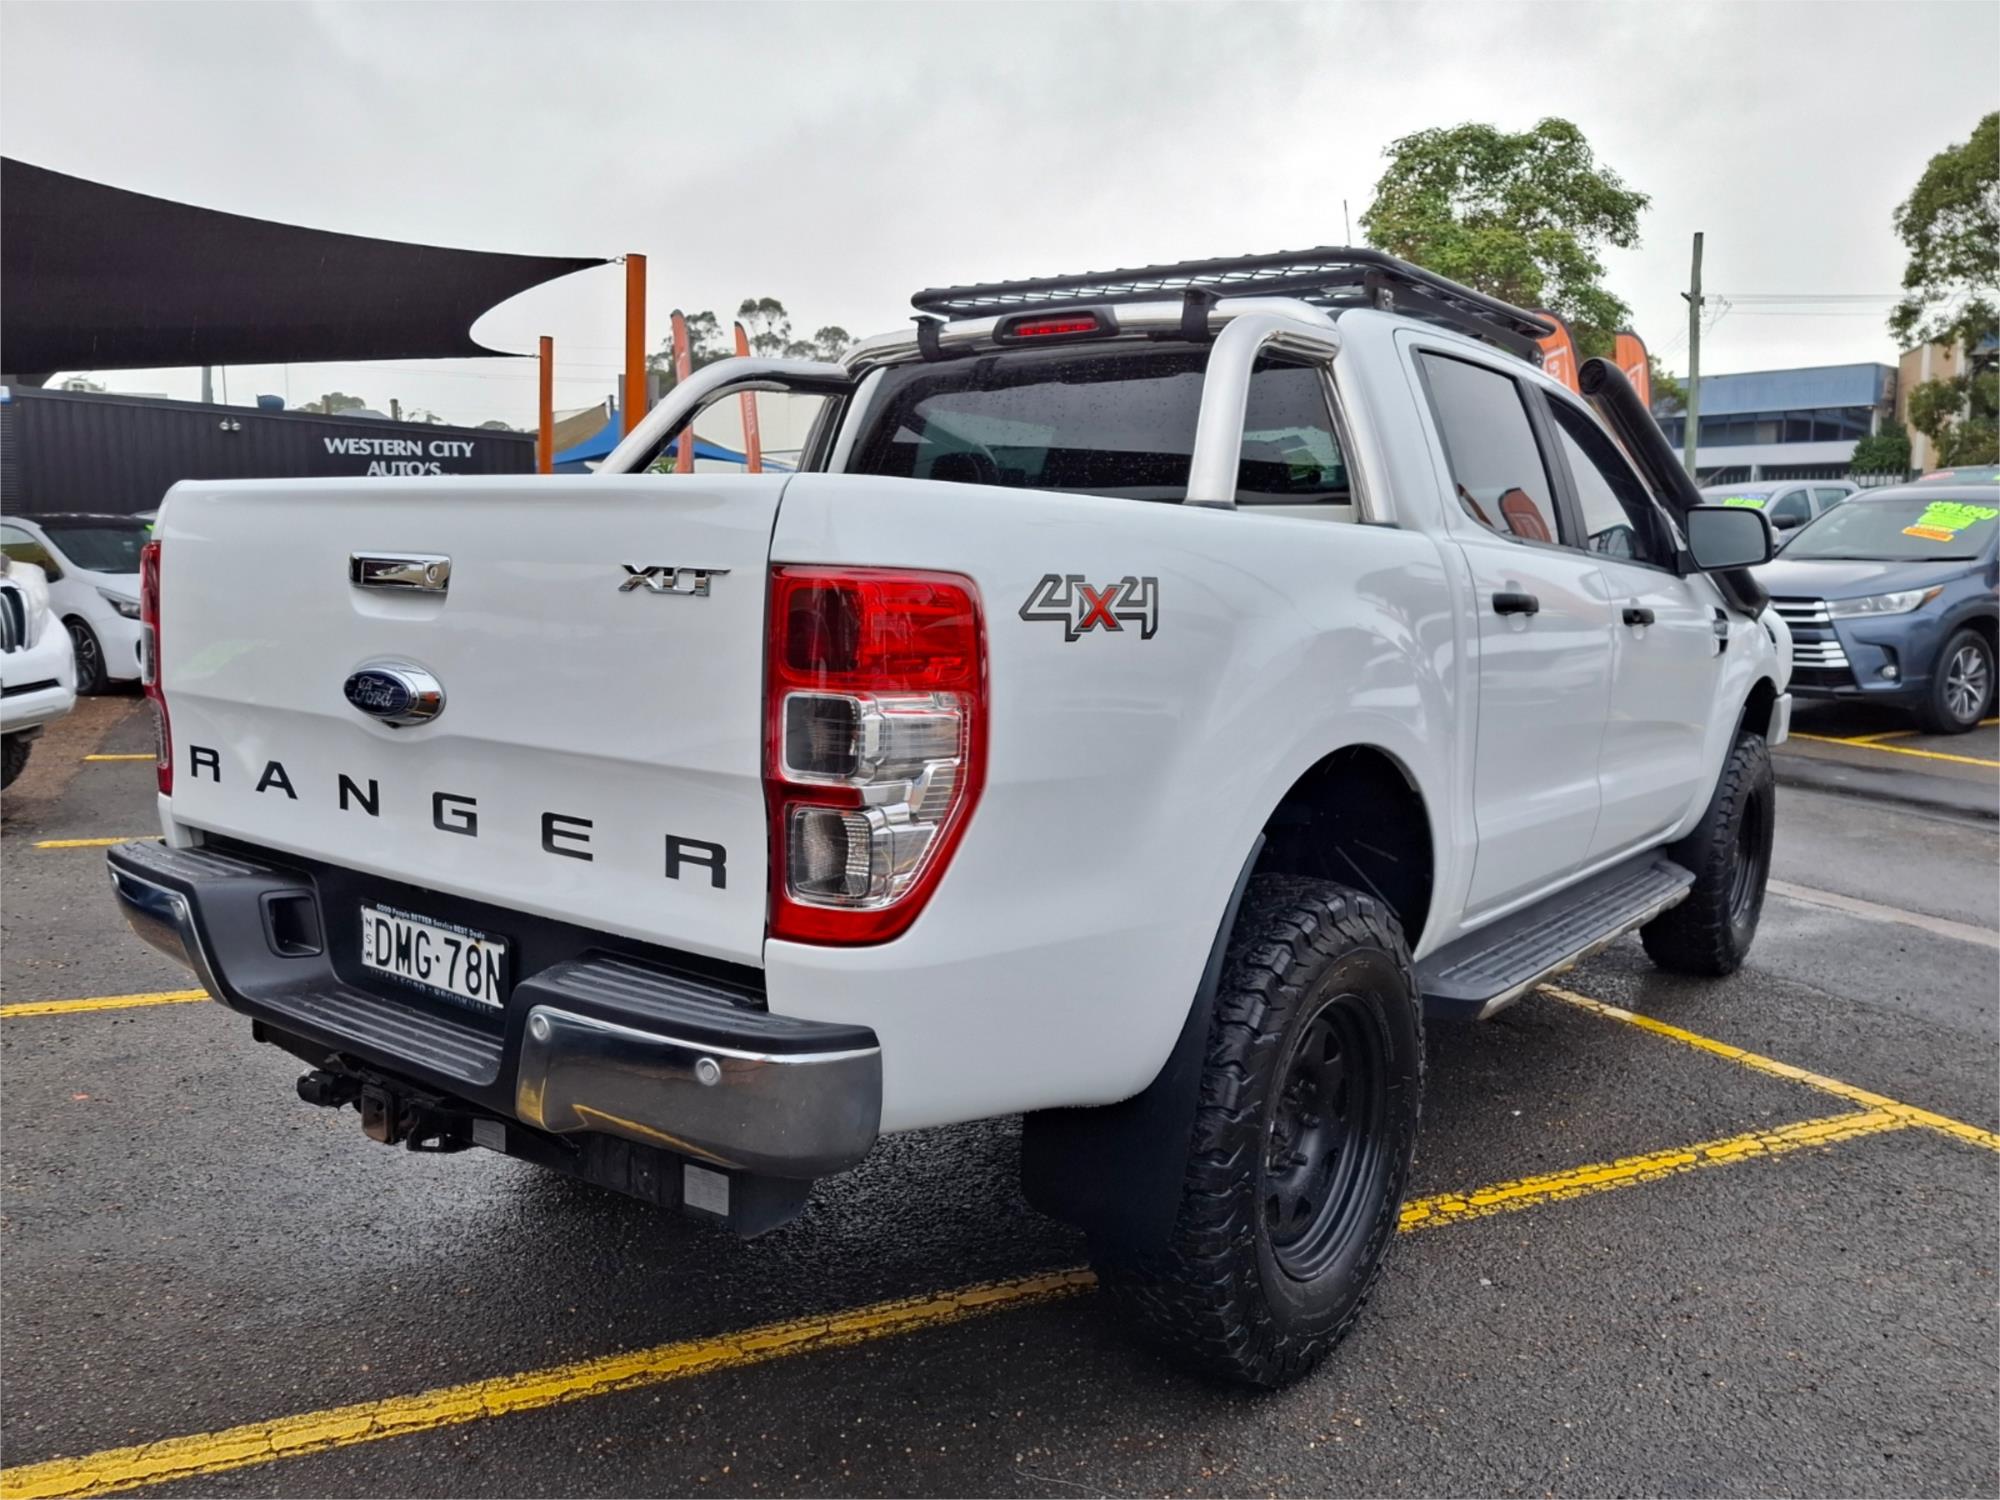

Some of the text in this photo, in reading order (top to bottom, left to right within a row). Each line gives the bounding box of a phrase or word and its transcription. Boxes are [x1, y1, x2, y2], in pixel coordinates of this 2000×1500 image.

[323, 437, 474, 457] WESTERN CITY
[367, 461, 441, 476] AUTO'S
[618, 562, 732, 597] XLT
[353, 675, 395, 708] Ford
[189, 744, 727, 889] RANGER
[410, 913, 432, 925] BETTER
[453, 924, 468, 936] BEST
